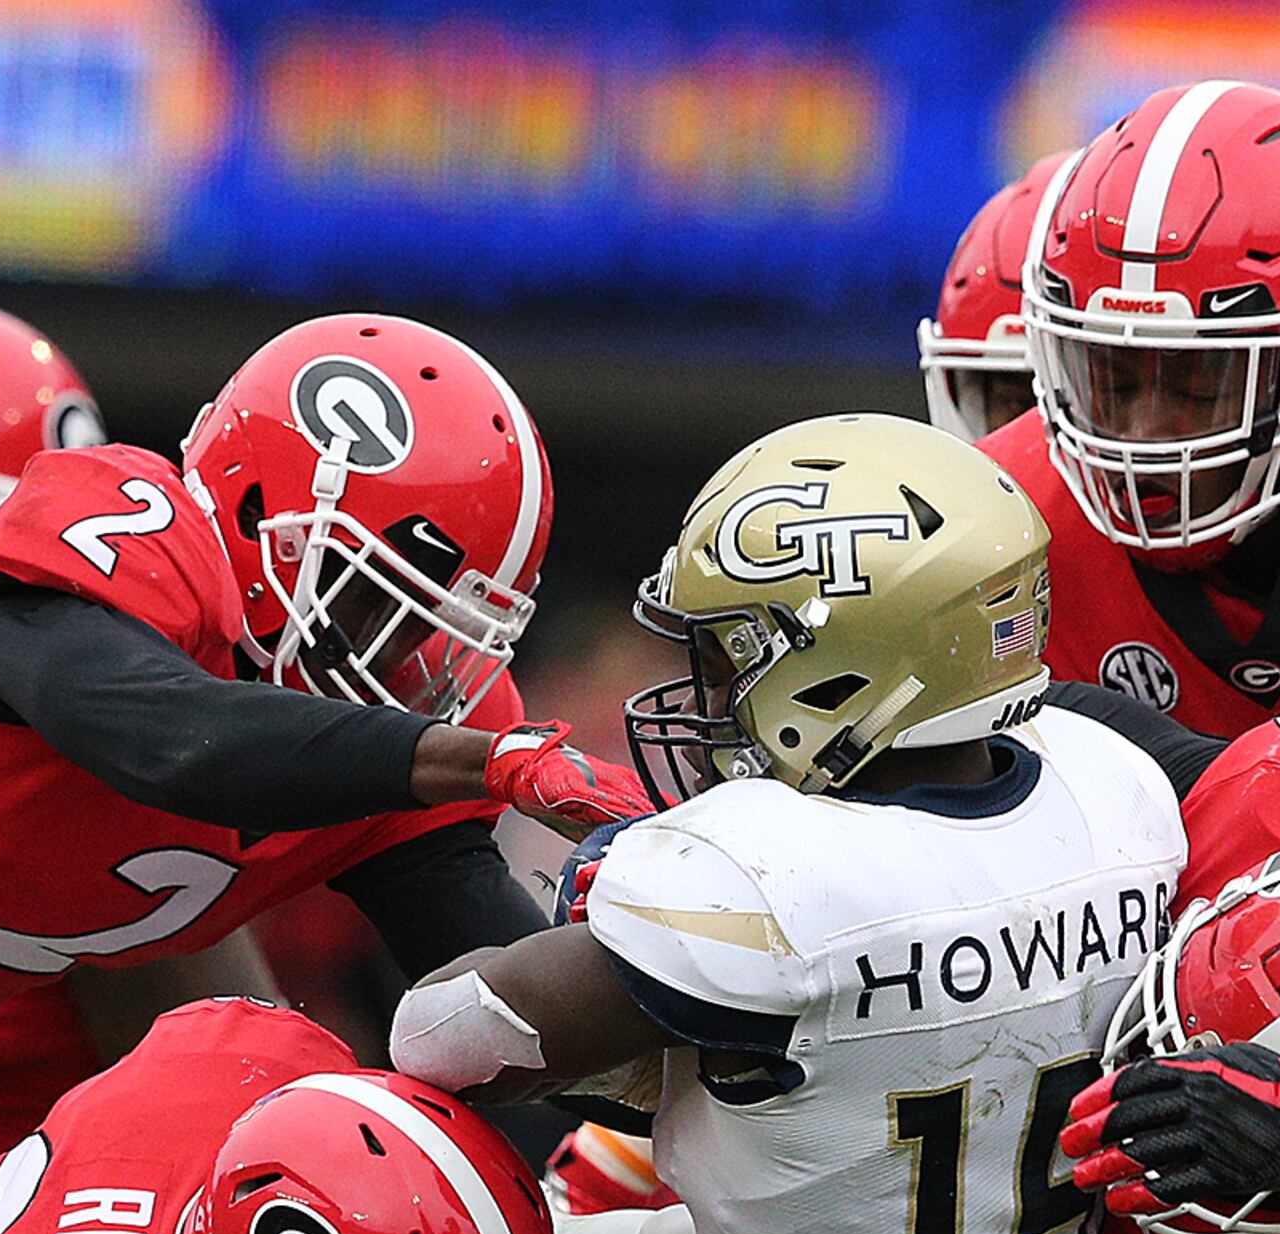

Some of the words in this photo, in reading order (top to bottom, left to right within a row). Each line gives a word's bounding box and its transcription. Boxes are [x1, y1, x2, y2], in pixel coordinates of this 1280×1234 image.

[1102, 297, 1166, 314] DAWGS
[61, 479, 175, 577] 2
[715, 482, 908, 598] GT
[1106, 649, 1173, 708] SEC
